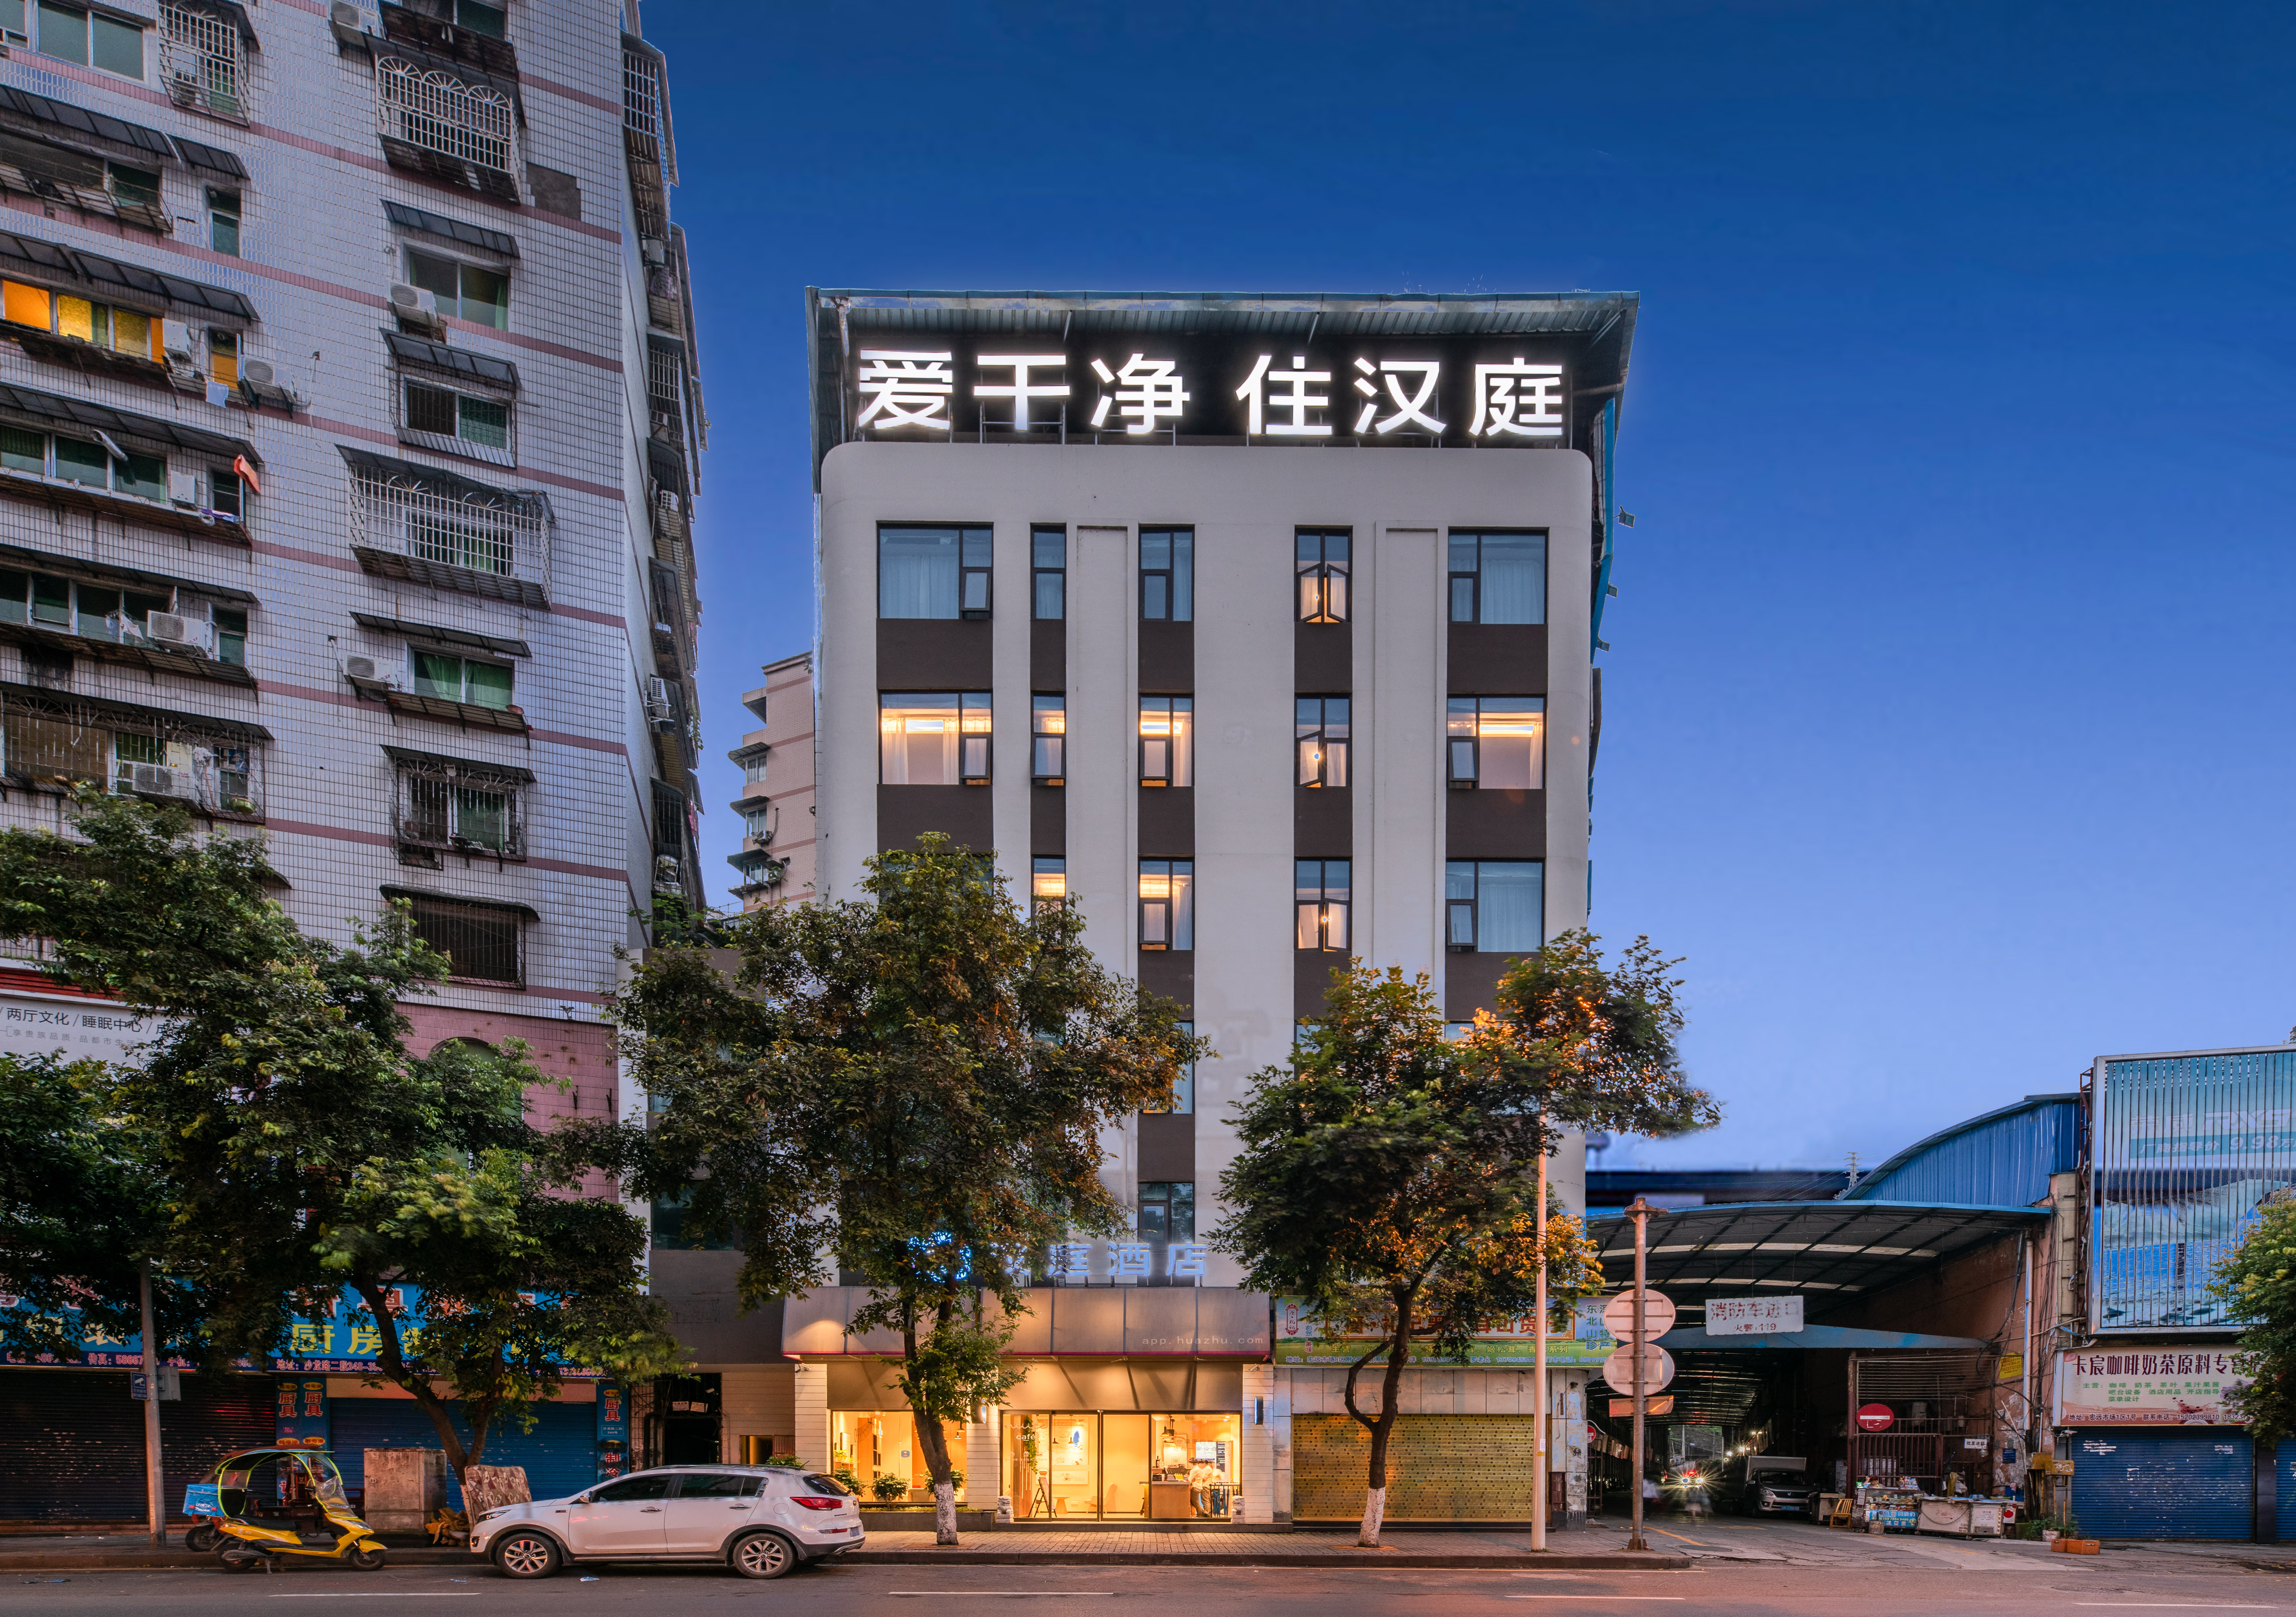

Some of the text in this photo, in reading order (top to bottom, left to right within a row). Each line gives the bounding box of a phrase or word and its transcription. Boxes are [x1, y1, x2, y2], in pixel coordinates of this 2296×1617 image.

[857, 349, 1563, 437] 爱干净 住汉庭
[2131, 1113, 2193, 1134] 荣威
[2140, 1135, 2296, 1154] 厂商指导价 9.98万
[1711, 1300, 1798, 1321] 消防车进口
[278, 1391, 323, 1418] 厨具 厨具
[604, 1398, 621, 1422] 厨具
